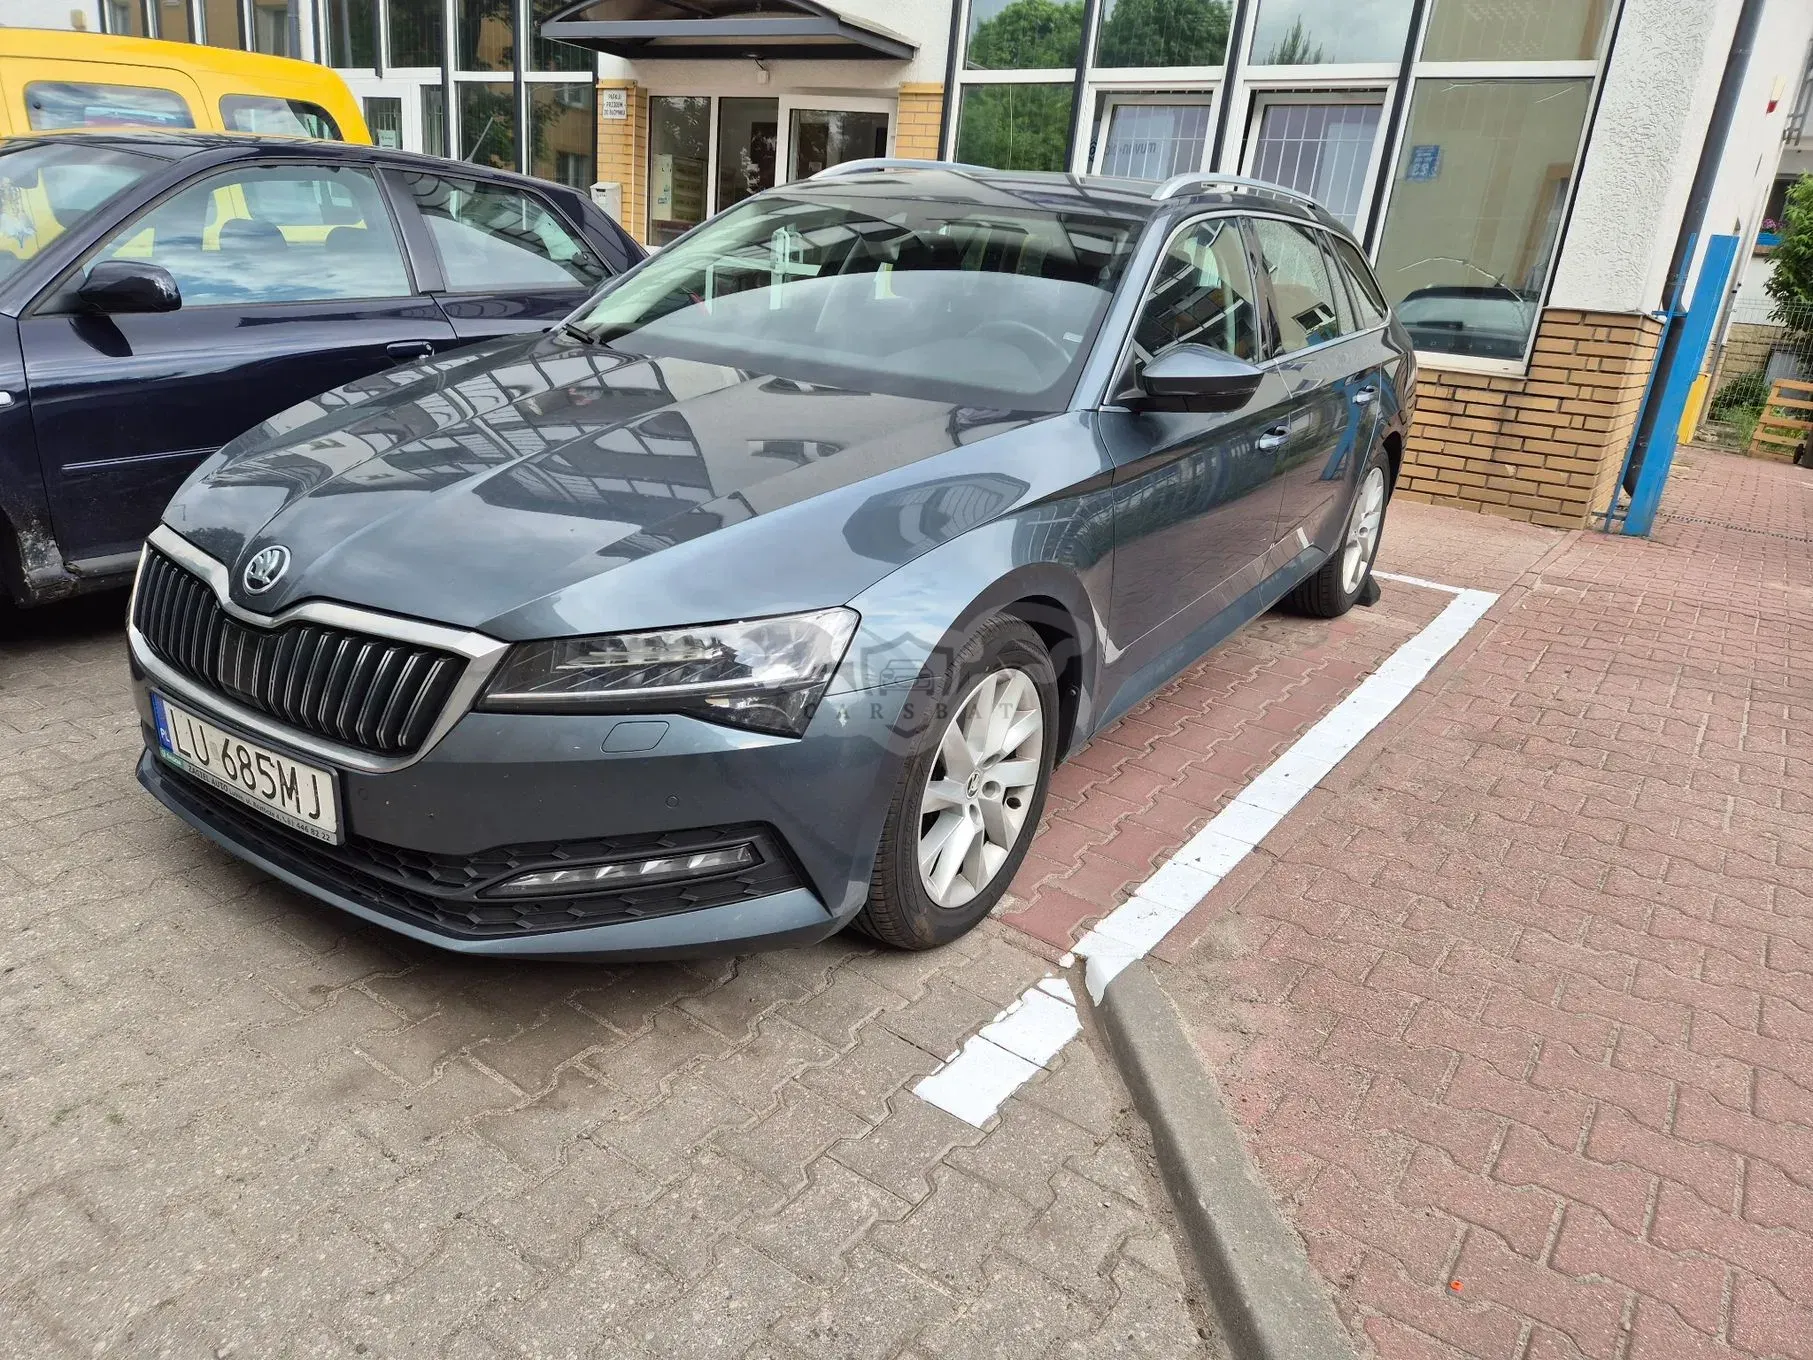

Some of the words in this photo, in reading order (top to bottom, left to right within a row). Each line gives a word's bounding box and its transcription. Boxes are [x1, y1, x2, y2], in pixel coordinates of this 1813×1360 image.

[160, 727, 171, 743] PL
[170, 708, 210, 767] LU
[221, 737, 321, 820] 685MJ
